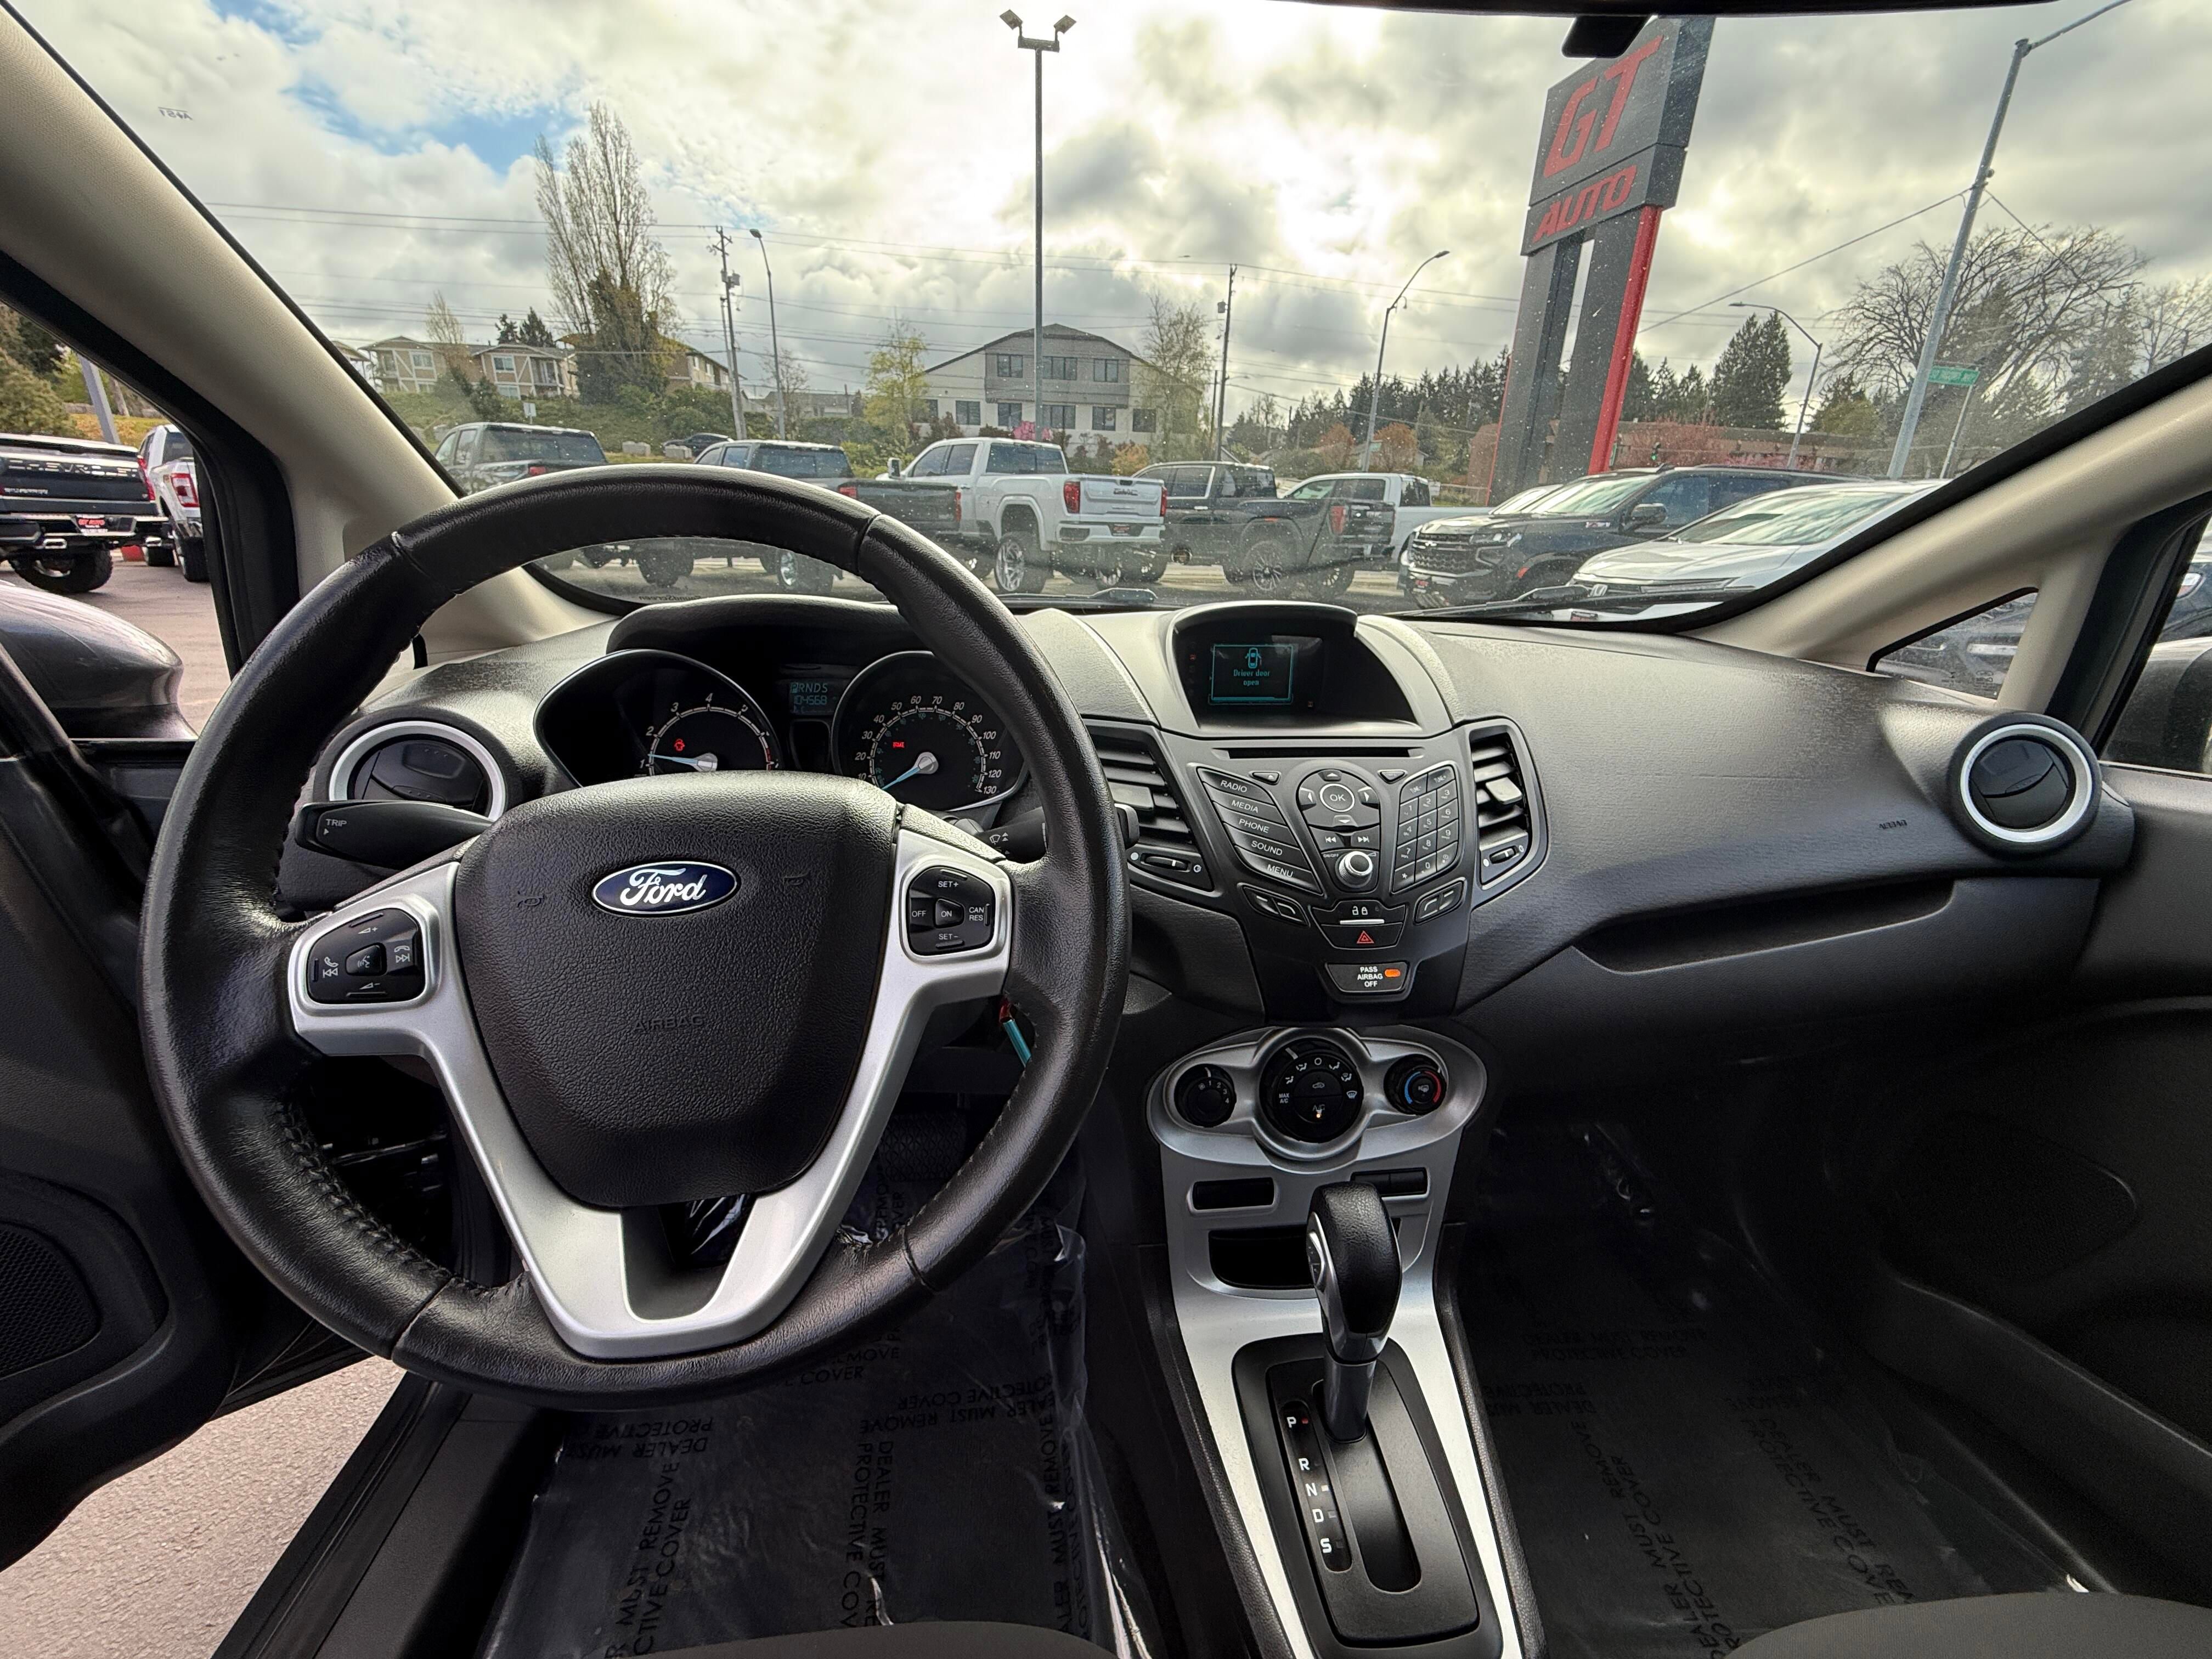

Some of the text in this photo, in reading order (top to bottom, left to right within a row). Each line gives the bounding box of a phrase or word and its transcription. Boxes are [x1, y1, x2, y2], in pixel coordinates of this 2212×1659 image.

[1544, 34, 1664, 178] GT
[1533, 165, 1637, 243] AUTO
[1233, 669, 1254, 677] Driver
[706, 693, 713, 702] 4
[911, 696, 922, 704] 60
[932, 696, 943, 705] 70
[671, 702, 679, 712] 3
[891, 702, 902, 710] 50
[953, 702, 964, 710] 80
[873, 715, 884, 723] 40
[972, 715, 983, 724] 90
[646, 726, 654, 736] 2
[862, 731, 873, 740] 30
[983, 731, 996, 740] 100
[855, 752, 866, 761] 20
[989, 751, 1001, 759] 110
[640, 759, 645, 768] 1
[988, 770, 1002, 778] 120
[983, 786, 997, 794] 130
[1220, 780, 1248, 793] RADIO
[1330, 794, 1346, 802] OK
[1231, 799, 1259, 814] MEDIA
[325, 818, 347, 827] TRIP
[1239, 819, 1270, 834] PHONE
[1251, 840, 1283, 856] SOUND
[1267, 864, 1294, 878] MENU
[620, 868, 708, 906] Ford
[633, 1014, 707, 1031] AIRBAG
[800, 1365, 865, 1385] COVER
[898, 1391, 961, 1410] COVER
[950, 1406, 996, 1423] MUST
[596, 1417, 714, 1439] PROTECTIVE
[859, 1412, 938, 1435] REMOVE
[1286, 1417, 1296, 1428] P
[633, 1437, 708, 1458] DEALER
[1039, 1410, 1059, 1496] REMOVE
[1299, 1458, 1310, 1471] R
[1570, 1421, 1626, 1499] REMOVE
[873, 1440, 894, 1514] DEALER
[1306, 1482, 1318, 1497] N
[1611, 1455, 1662, 1526] COVER
[638, 1462, 680, 1551] REMOVE
[845, 1442, 874, 1563] PROTECTIVE
[1312, 1508, 1324, 1523] D
[655, 1497, 692, 1579] COVER
[1047, 1509, 1068, 1565] MUST
[1621, 1511, 1667, 1570] MUST
[1320, 1538, 1332, 1554] S
